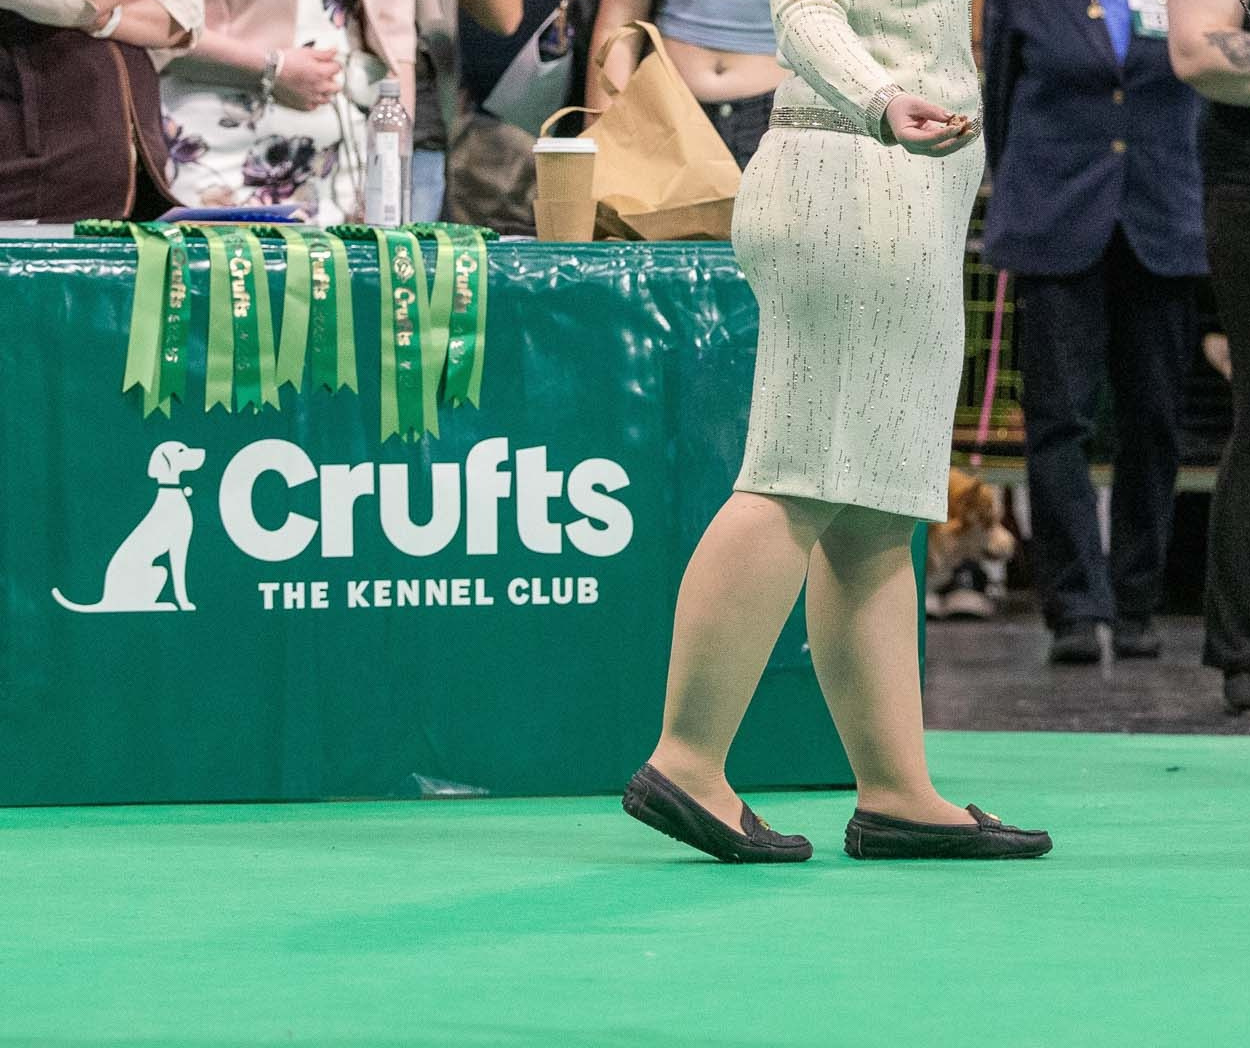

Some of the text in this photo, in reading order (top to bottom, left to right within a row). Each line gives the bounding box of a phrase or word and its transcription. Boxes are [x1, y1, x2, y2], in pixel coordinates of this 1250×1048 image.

[229, 256, 252, 318] Crufts
[393, 286, 416, 347] Crufts
[219, 437, 634, 562] Crufts
[258, 577, 599, 610] THE KENNEL CLUB
